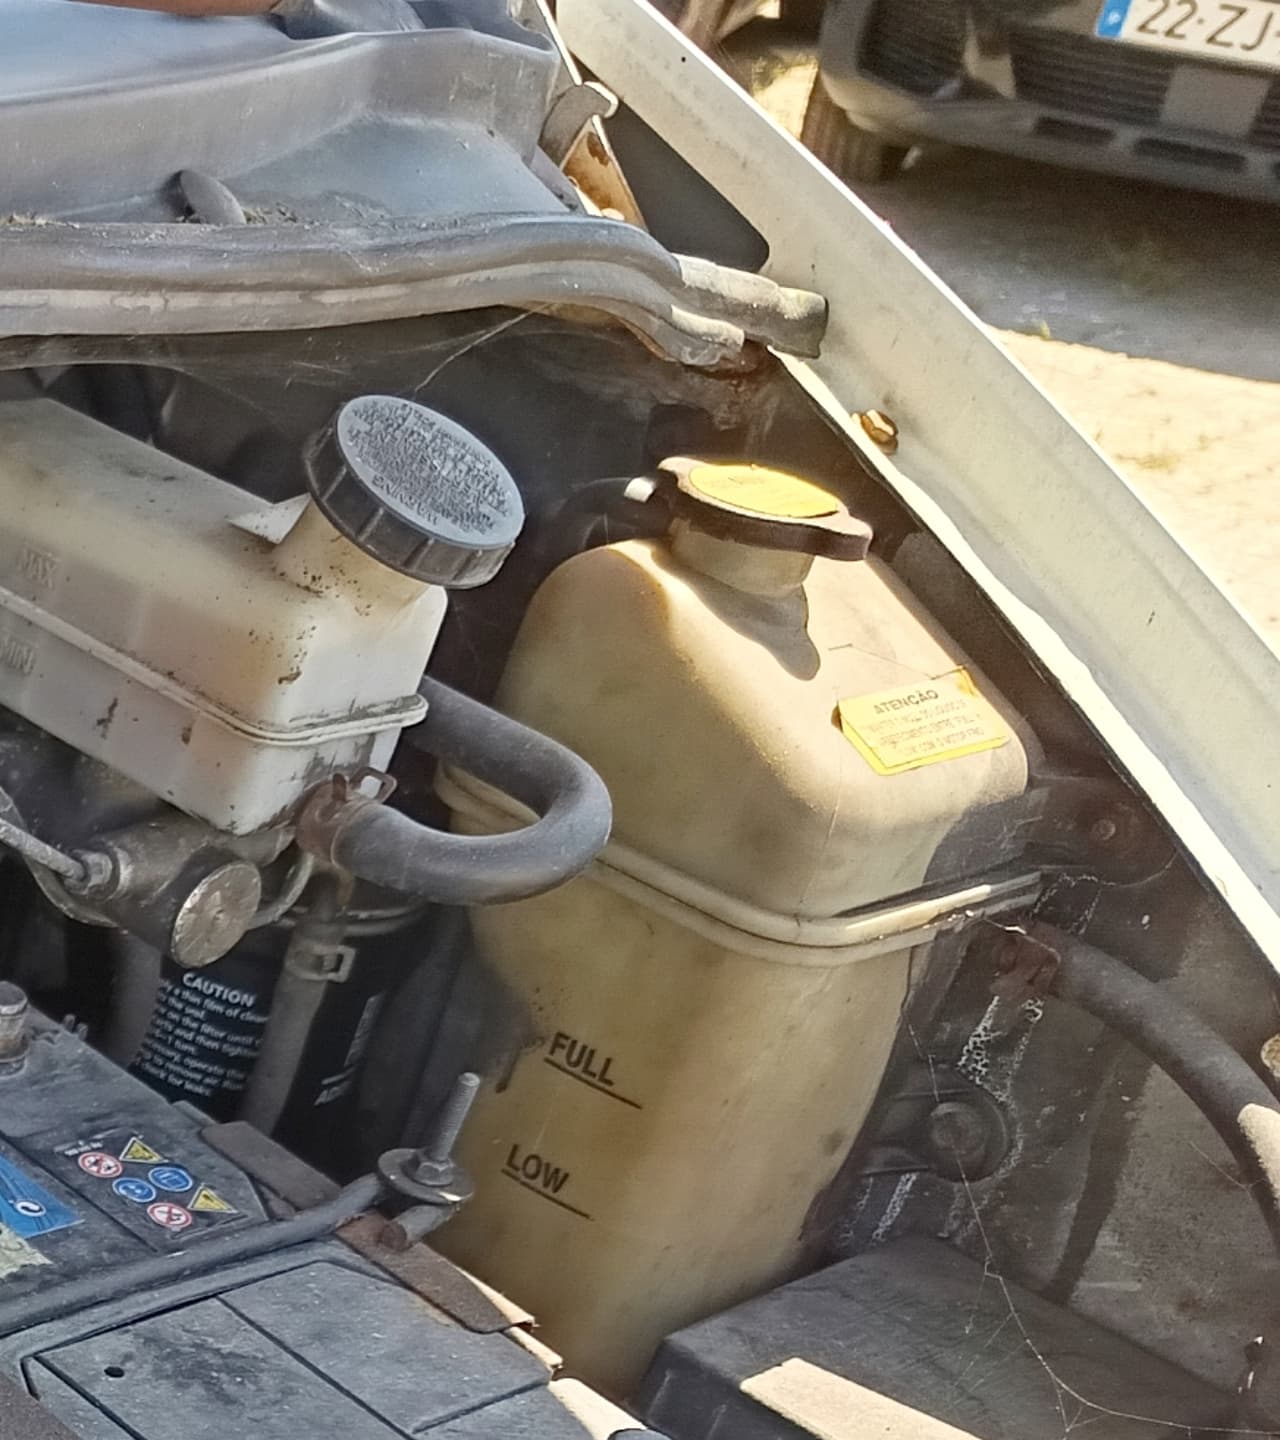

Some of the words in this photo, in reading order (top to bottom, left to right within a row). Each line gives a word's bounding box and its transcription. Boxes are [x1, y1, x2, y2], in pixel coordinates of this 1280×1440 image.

[182, 971, 256, 1007] CAUTION
[548, 1031, 615, 1087] FULL
[505, 1144, 570, 1194] LOW
